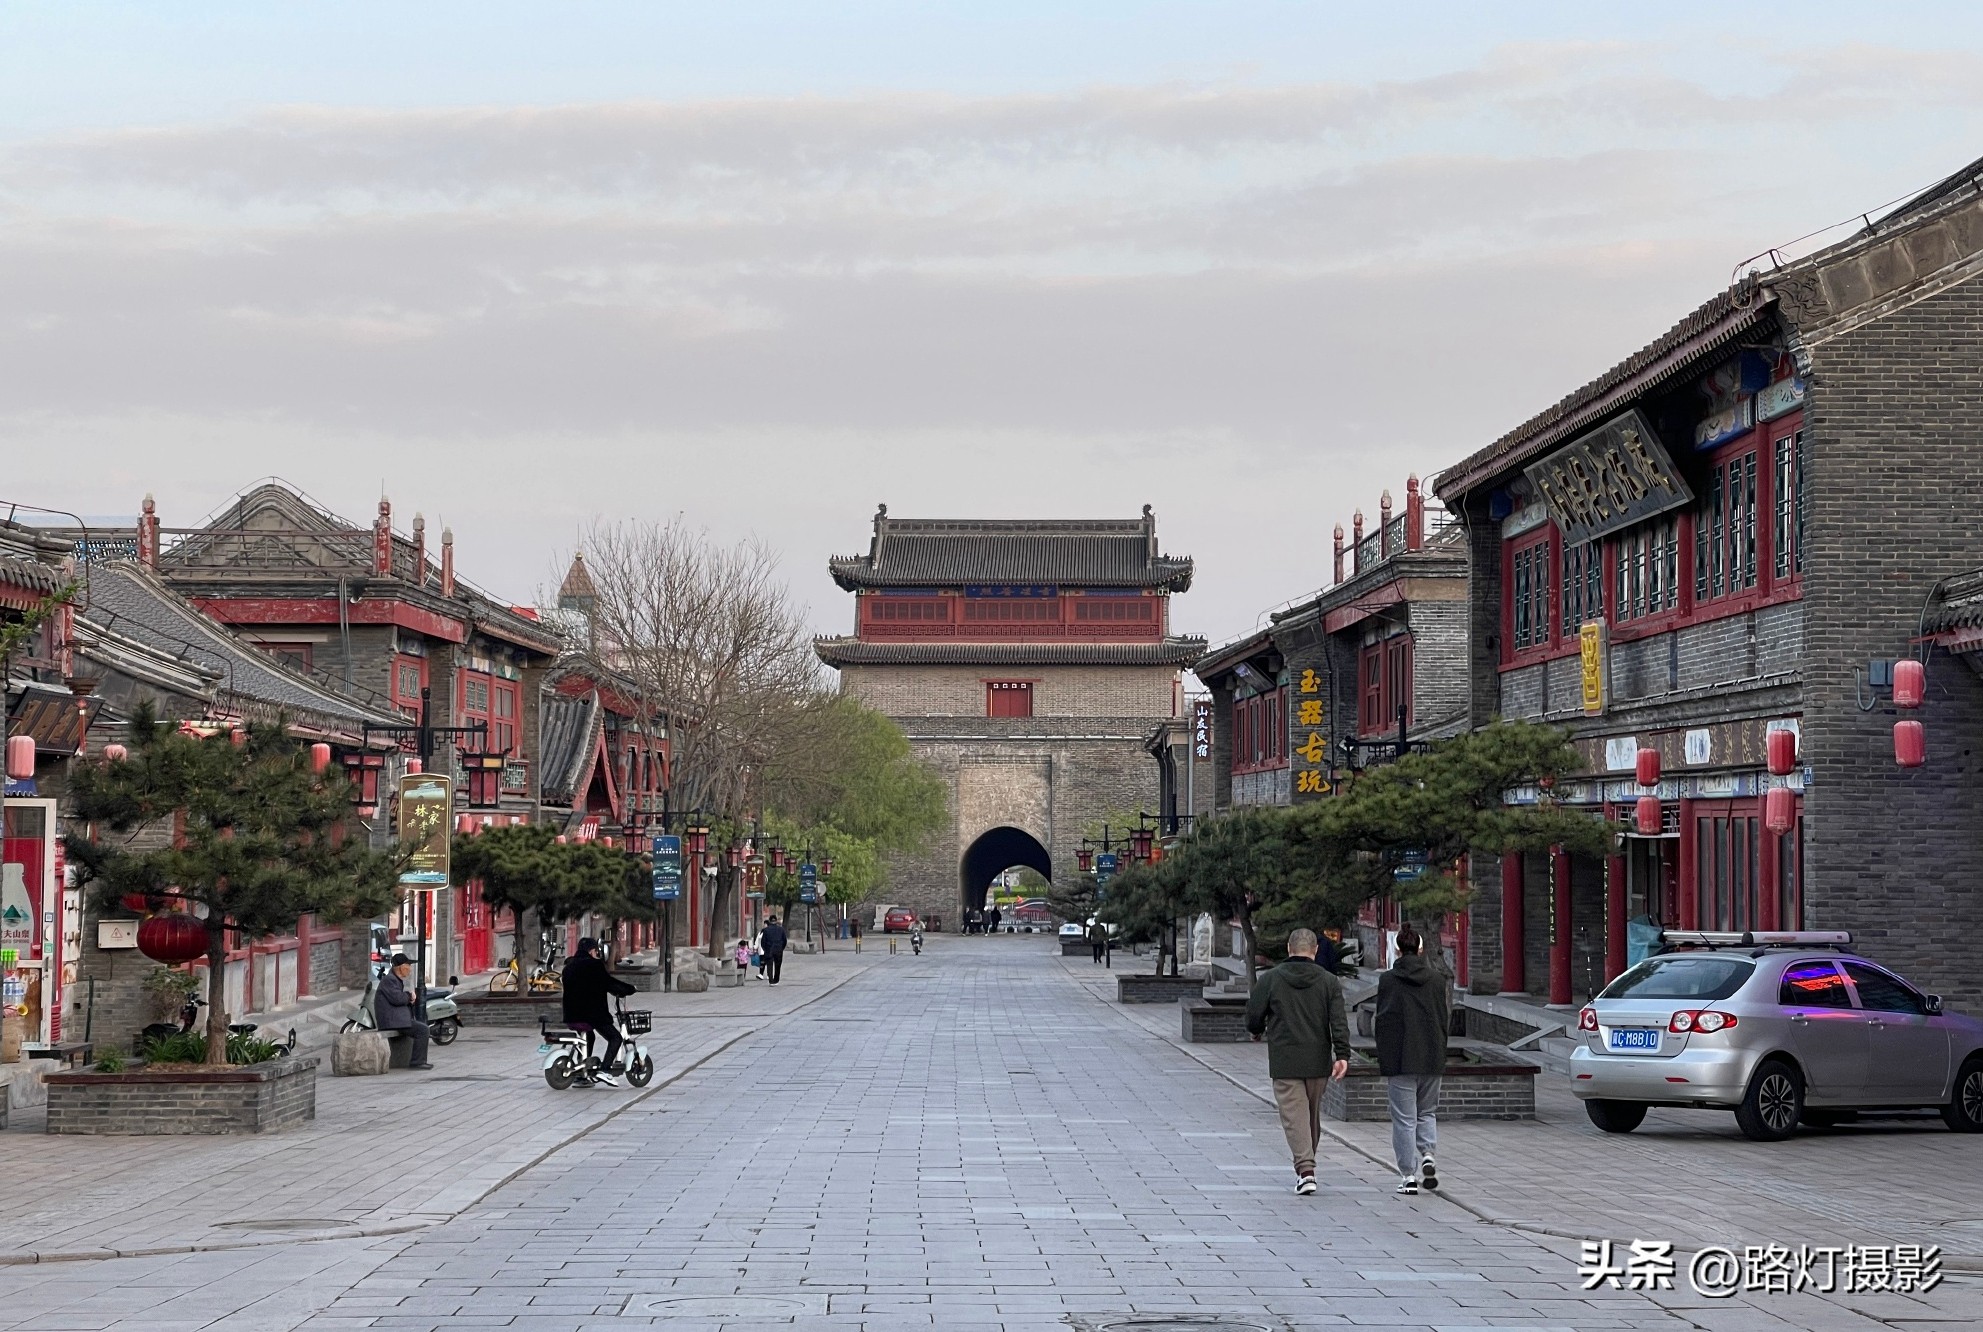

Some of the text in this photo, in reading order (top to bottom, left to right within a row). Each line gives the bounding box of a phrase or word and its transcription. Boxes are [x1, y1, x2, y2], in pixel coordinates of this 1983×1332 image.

[1196, 705, 1208, 757] 山友民宿
[1296, 669, 1331, 792] 玉器古玩
